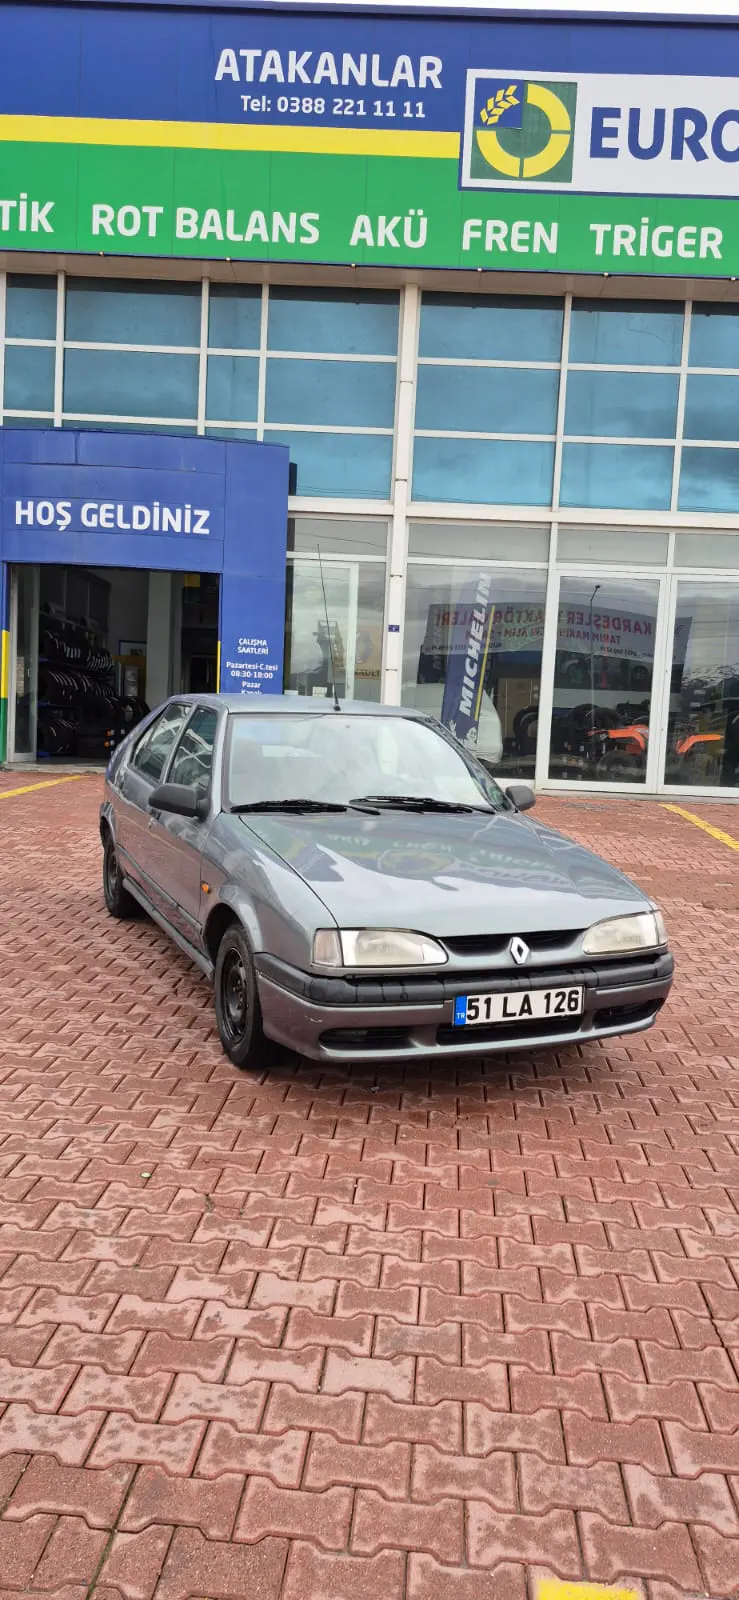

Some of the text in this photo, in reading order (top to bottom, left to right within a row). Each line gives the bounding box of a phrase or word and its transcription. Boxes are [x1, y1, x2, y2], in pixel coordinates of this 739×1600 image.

[214, 48, 443, 89] ATAKANLAR
[240, 95, 426, 118] Tel: 0388 221 11 11
[589, 106, 739, 163] EURO
[92, 203, 164, 237] ROT
[176, 207, 320, 244] BALANS
[350, 209, 428, 248] AKÜ
[461, 218, 559, 254] FREN
[590, 217, 724, 259] TRİGER
[15, 500, 211, 535] HOŞ GELDİNİZ
[459, 571, 492, 717] MICHELIN
[466, 990, 580, 1020] 51 LA 126
